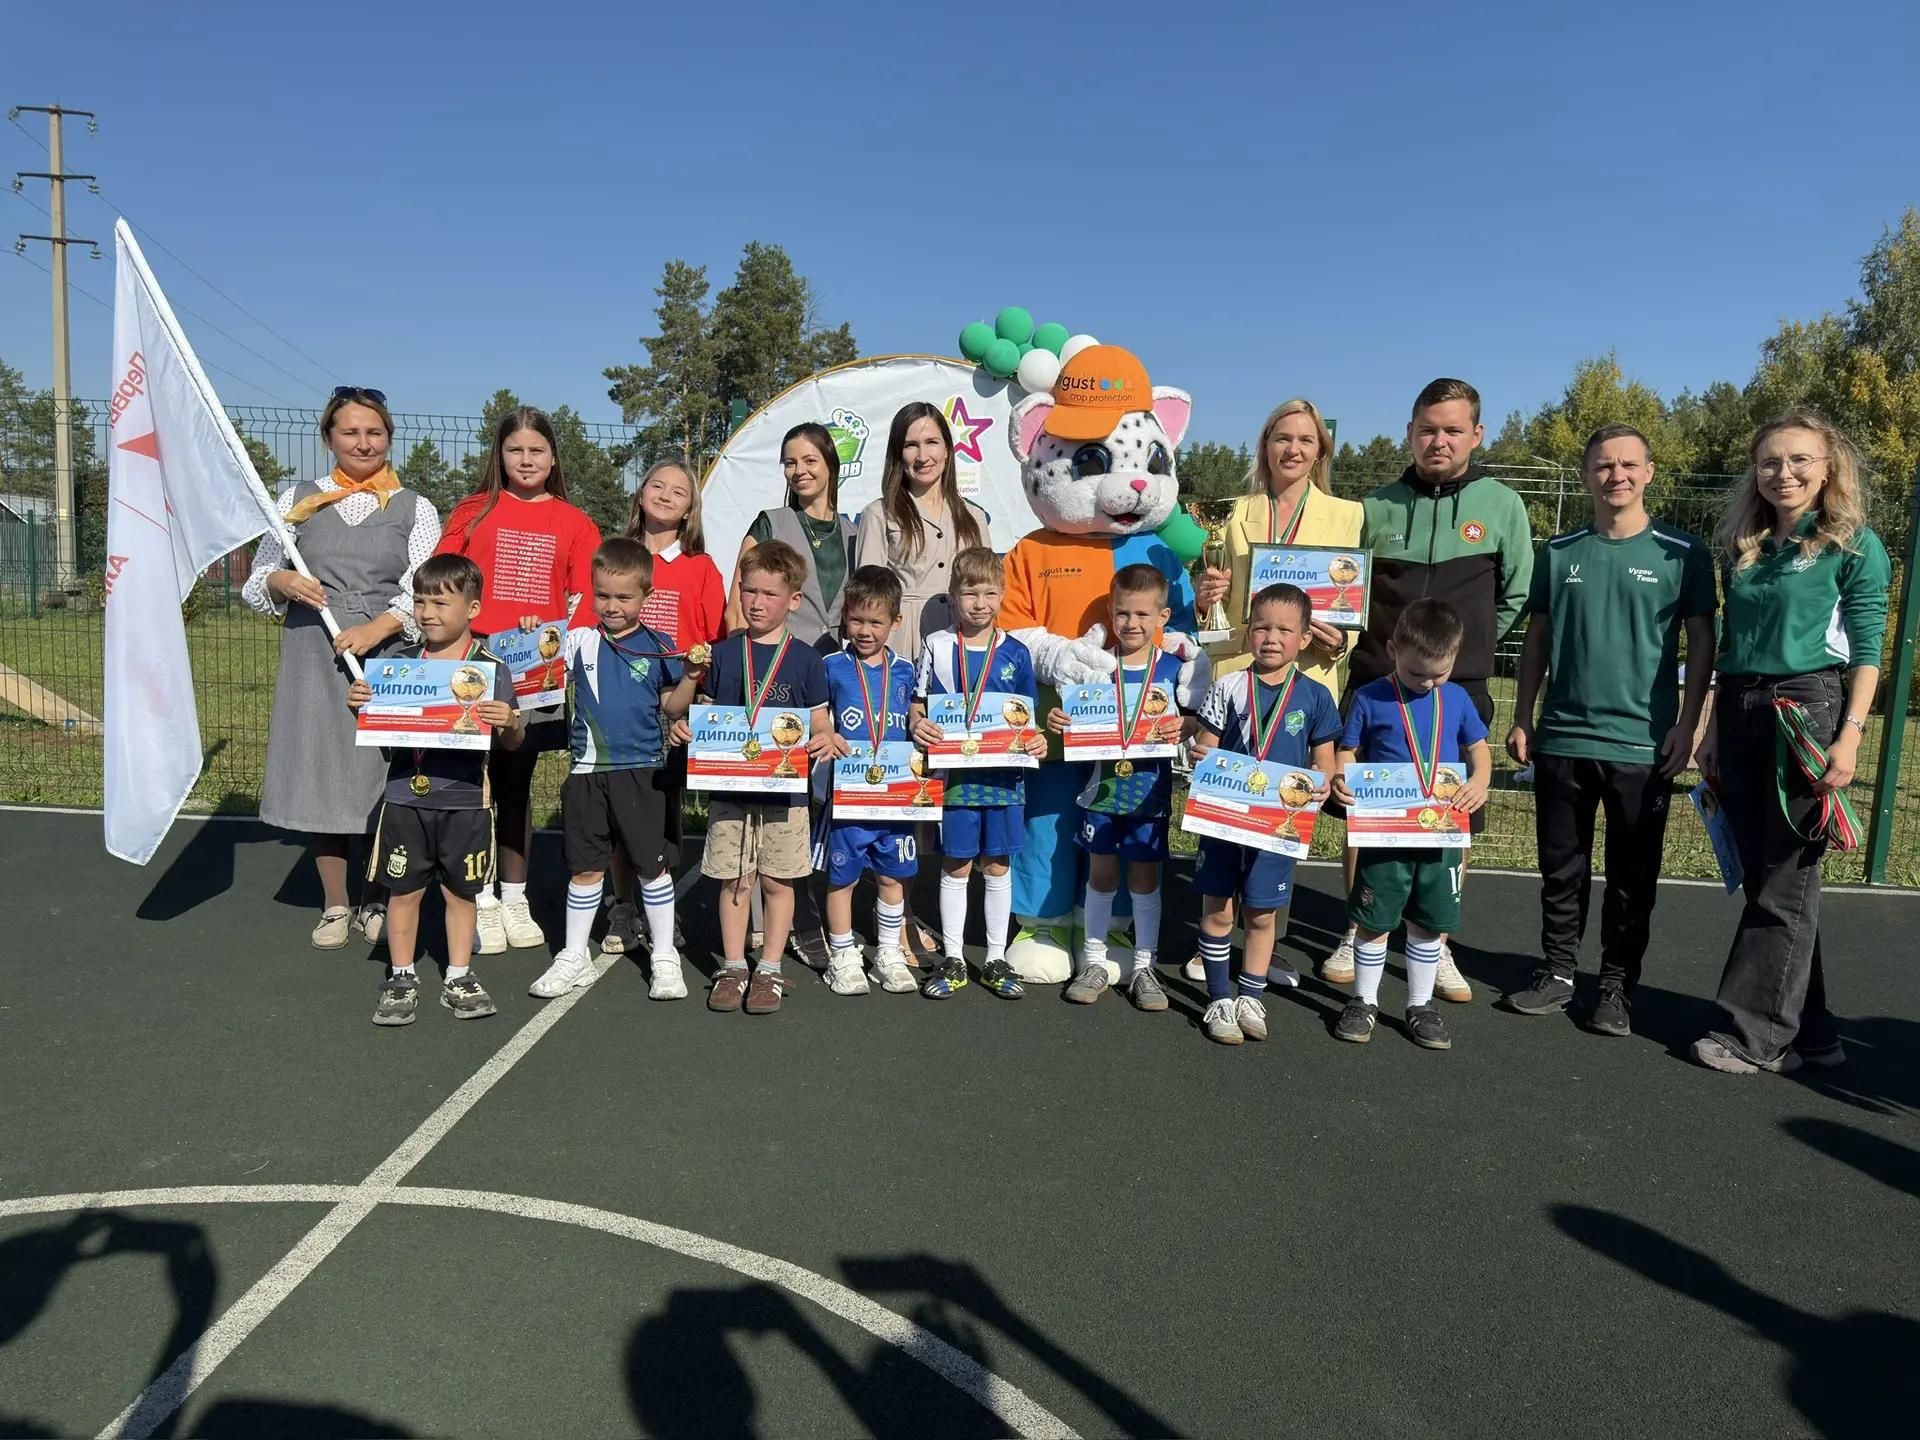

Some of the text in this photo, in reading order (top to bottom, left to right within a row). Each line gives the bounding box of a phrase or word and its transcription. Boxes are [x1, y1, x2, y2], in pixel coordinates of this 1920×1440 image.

[1061, 375, 1096, 391] gust
[1069, 392, 1133, 404] crop protection
[1259, 569, 1318, 581] ДИПЛОМ
[1628, 567, 1653, 576] Vyzov
[1636, 575, 1659, 583] Team
[502, 650, 532, 665] ИПЛОМ
[371, 682, 438, 696] ДИПЛОМ
[1070, 704, 1116, 717] ДИПЛО
[936, 713, 993, 725] ДИПОМ
[696, 730, 760, 743] ДИПЛОМ
[841, 763, 899, 775] ДИПОМ
[1354, 787, 1418, 799] ДИПЛОМ
[896, 835, 917, 863] 10
